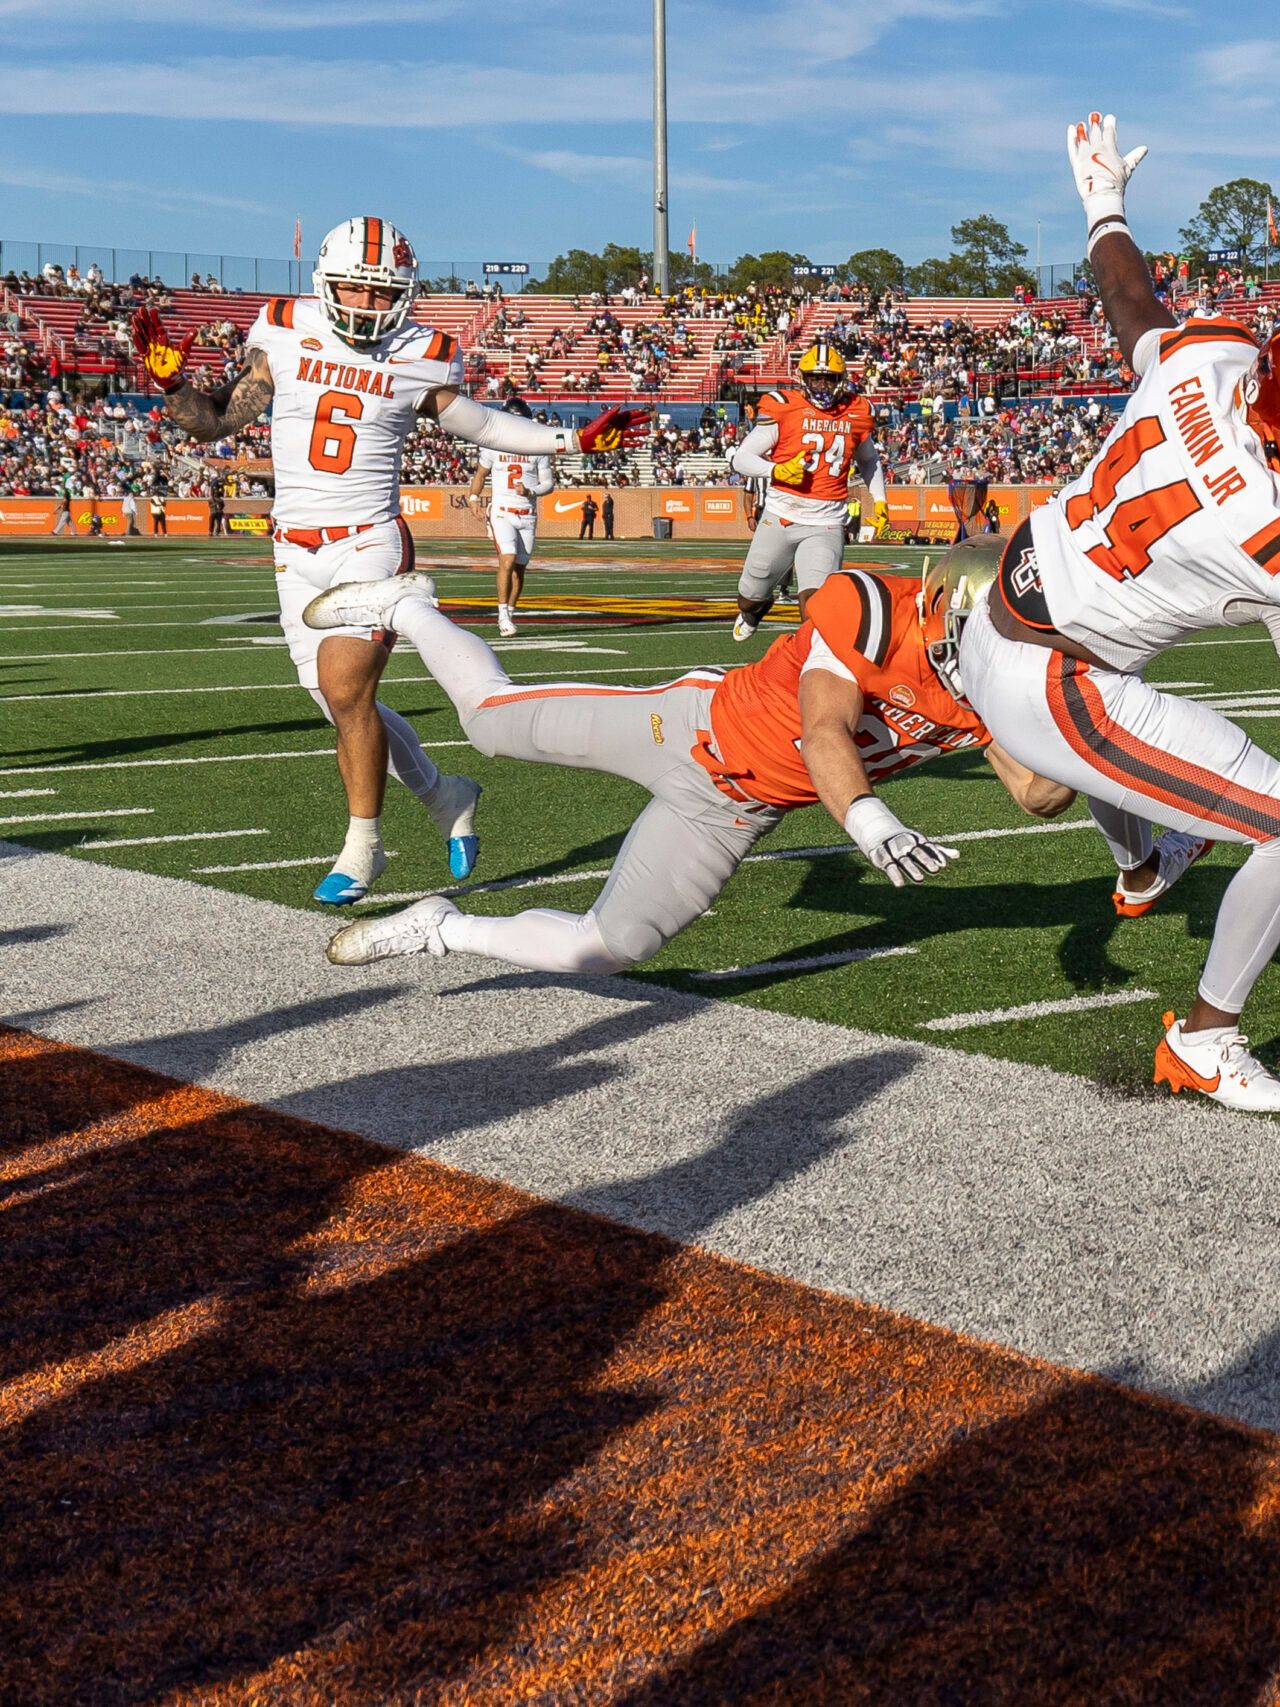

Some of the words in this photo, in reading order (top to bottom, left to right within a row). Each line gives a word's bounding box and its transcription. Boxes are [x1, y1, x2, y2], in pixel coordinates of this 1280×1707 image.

[1227, 251, 1238, 260] 222
[296, 356, 395, 399] NATIONAL
[308, 389, 364, 475] 6
[802, 417, 851, 434] AMERICAN
[1168, 376, 1224, 468] FANNIN
[1202, 465, 1247, 506] JR
[500, 454, 530, 463] NATIONAL
[801, 432, 845, 478] 34
[507, 464, 523, 489] 2
[399, 494, 430, 515] Lite
[1065, 414, 1205, 583] 44
